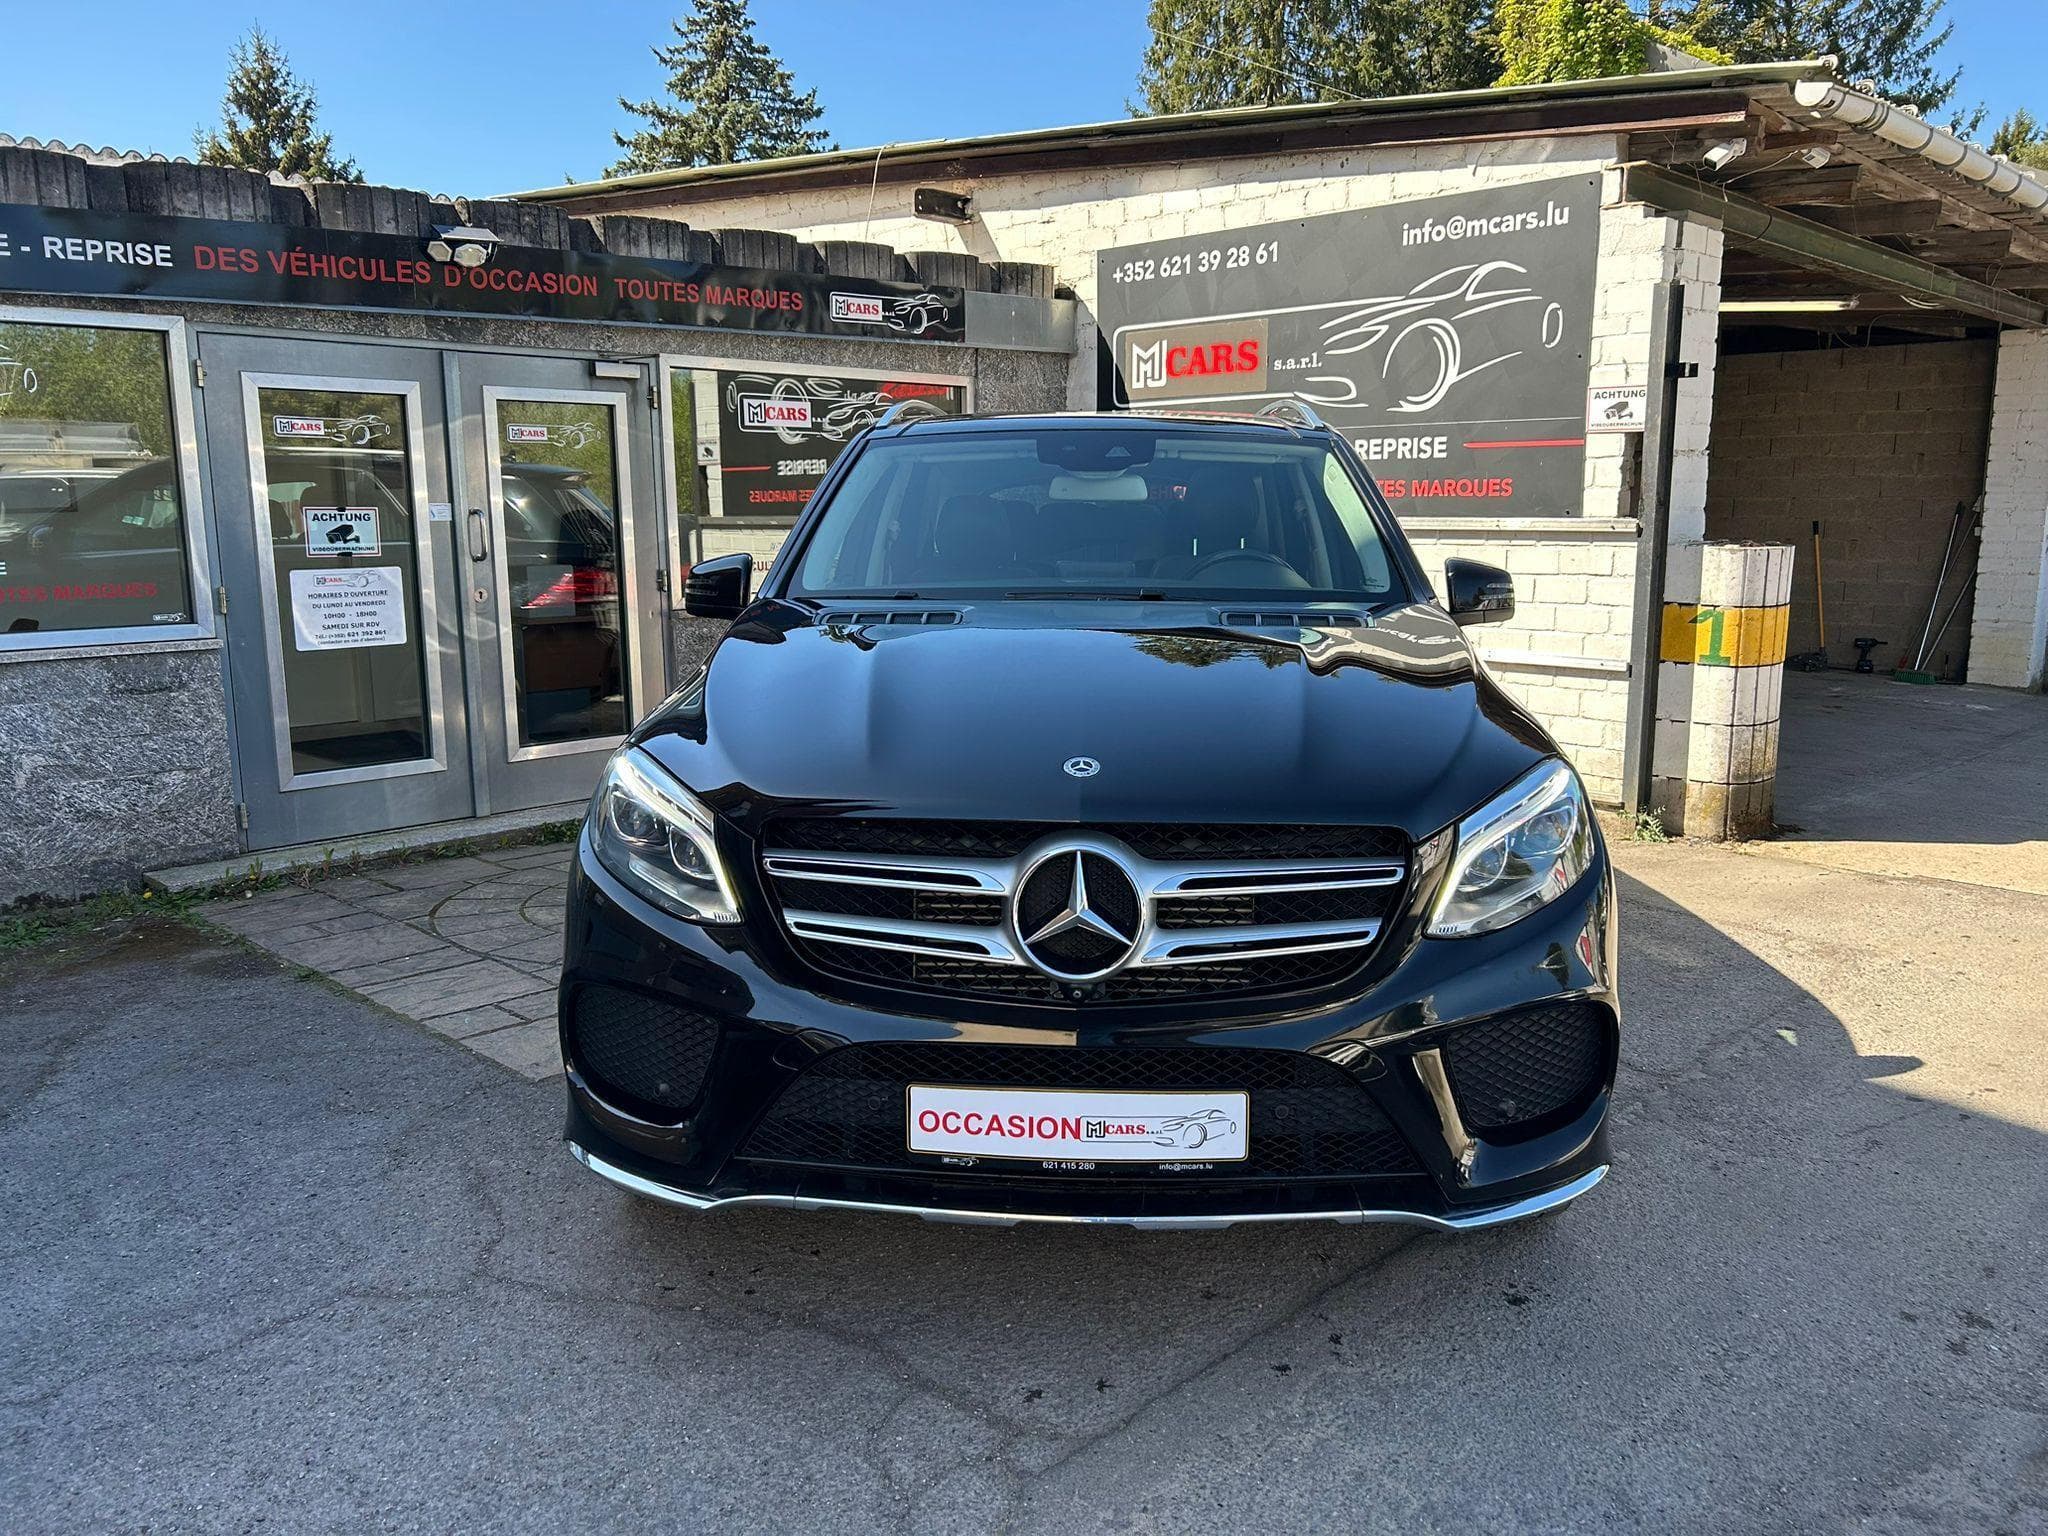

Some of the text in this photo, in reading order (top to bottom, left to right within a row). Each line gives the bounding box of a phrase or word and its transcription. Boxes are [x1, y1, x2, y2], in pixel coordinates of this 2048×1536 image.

[1402, 200, 1571, 246] info@mcars.lu
[1112, 241, 1278, 283] +352 621 39 28 61
[42, 236, 174, 267] REPRISE
[193, 245, 259, 273] DES
[267, 246, 432, 284] VÉHICULES
[444, 264, 599, 297] D'OCCASION
[614, 278, 700, 303] TOUTES
[705, 284, 804, 311] MARQUES
[1273, 352, 1322, 371] s.a.r.l.
[1594, 389, 1646, 400] ACHTUNG
[1354, 436, 1448, 461] REPRISE
[1411, 477, 1513, 498] MARQUES
[312, 513, 371, 522] ACHTUNG
[53, 582, 158, 600] MARQUES
[308, 591, 343, 599] HORAIRES
[356, 610, 377, 618] 18H00
[1688, 609, 1731, 666] 1
[918, 1109, 1080, 1140] OCCASION
[1042, 1161, 1213, 1171] 621 415 280 info@mcars.lu
